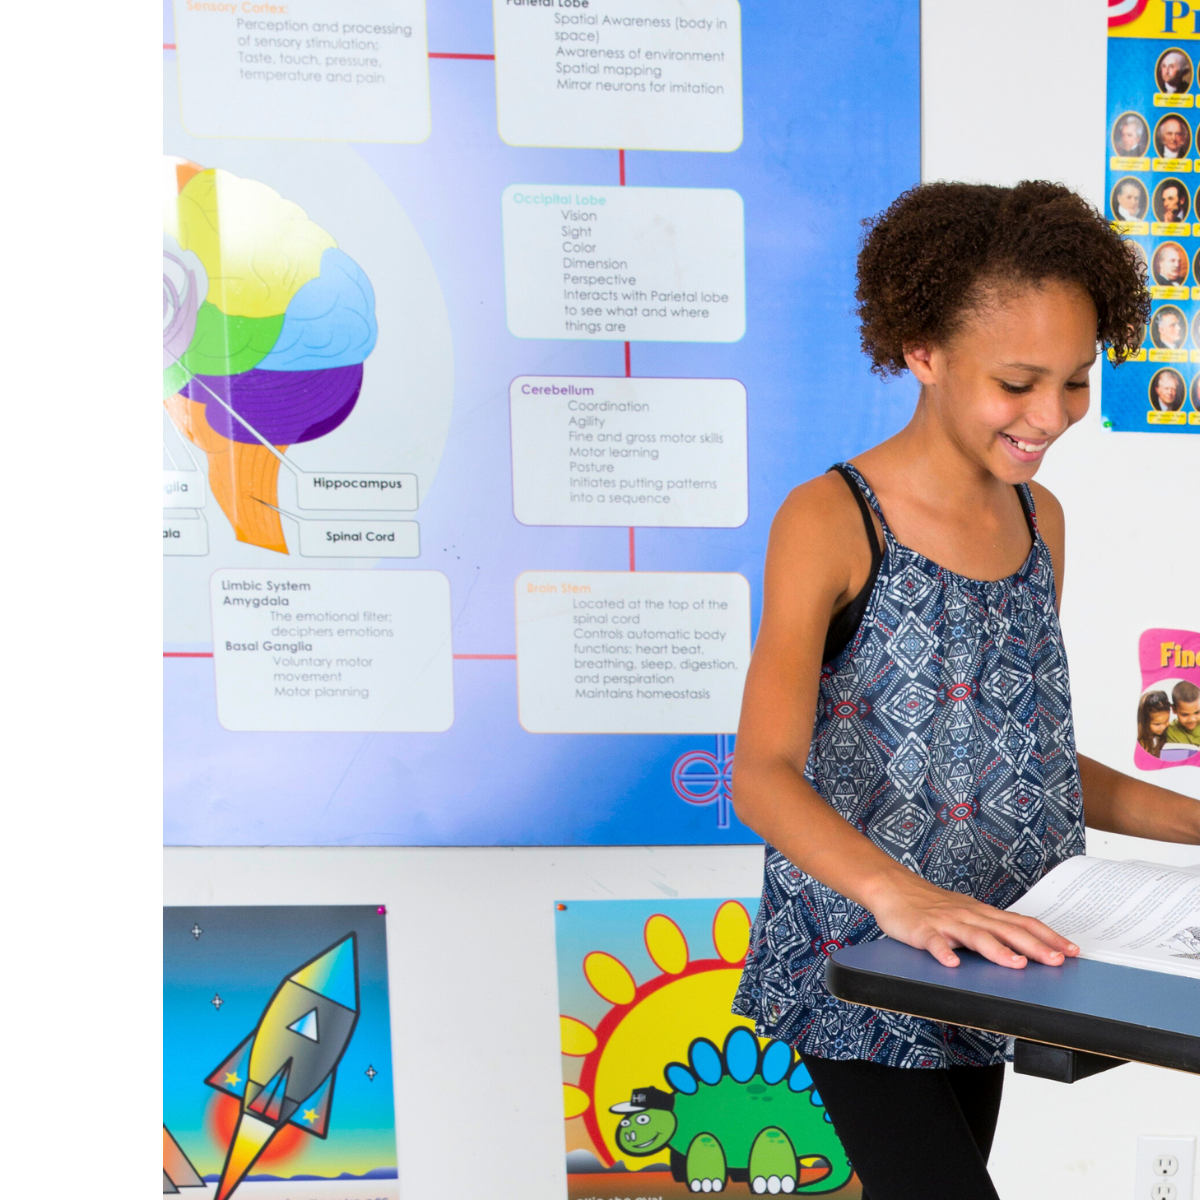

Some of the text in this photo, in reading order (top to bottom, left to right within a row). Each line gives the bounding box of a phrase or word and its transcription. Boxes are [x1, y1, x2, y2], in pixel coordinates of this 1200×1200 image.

[236, 18, 412, 38] Perception and processing
[553, 12, 727, 31] Spatial Awareness (body in
[554, 30, 599, 44] space)
[555, 45, 724, 62] Awareness of environment
[555, 61, 662, 79] Spatial mapping
[556, 77, 724, 94] Mirror neurons for imitation
[513, 192, 606, 207] Occipital Lobe
[560, 209, 597, 222] Vision
[561, 225, 592, 240] Sight
[561, 240, 596, 253] Color
[562, 256, 627, 270] Dimension
[563, 272, 636, 286] Perspective
[563, 289, 729, 303] Interacts with Parietal lobe
[564, 304, 709, 318] to see what and where
[564, 320, 626, 334] things are
[521, 383, 594, 396] Cerebellum
[567, 399, 649, 412] Coordination
[568, 415, 605, 429] Agility
[568, 430, 723, 445] Fine and gross motor skills
[568, 446, 659, 460] Motor learning
[569, 461, 614, 473] Posture
[313, 477, 402, 490] Hippocampus
[569, 476, 717, 491] Initiates putting patterns
[569, 491, 671, 505] into a sequence
[325, 531, 395, 543] Spinal Cord
[221, 579, 311, 593] Limbic System
[222, 595, 289, 608] Amygdala
[572, 598, 728, 611] Located at the top of the
[572, 612, 640, 626] spinal cord
[573, 627, 726, 641] Controls automatic body
[225, 640, 313, 654] Basal Ganglia
[635, 643, 668, 654] heart
[574, 673, 674, 686] and perspiration
[575, 687, 710, 699] Maintains homeostasis
